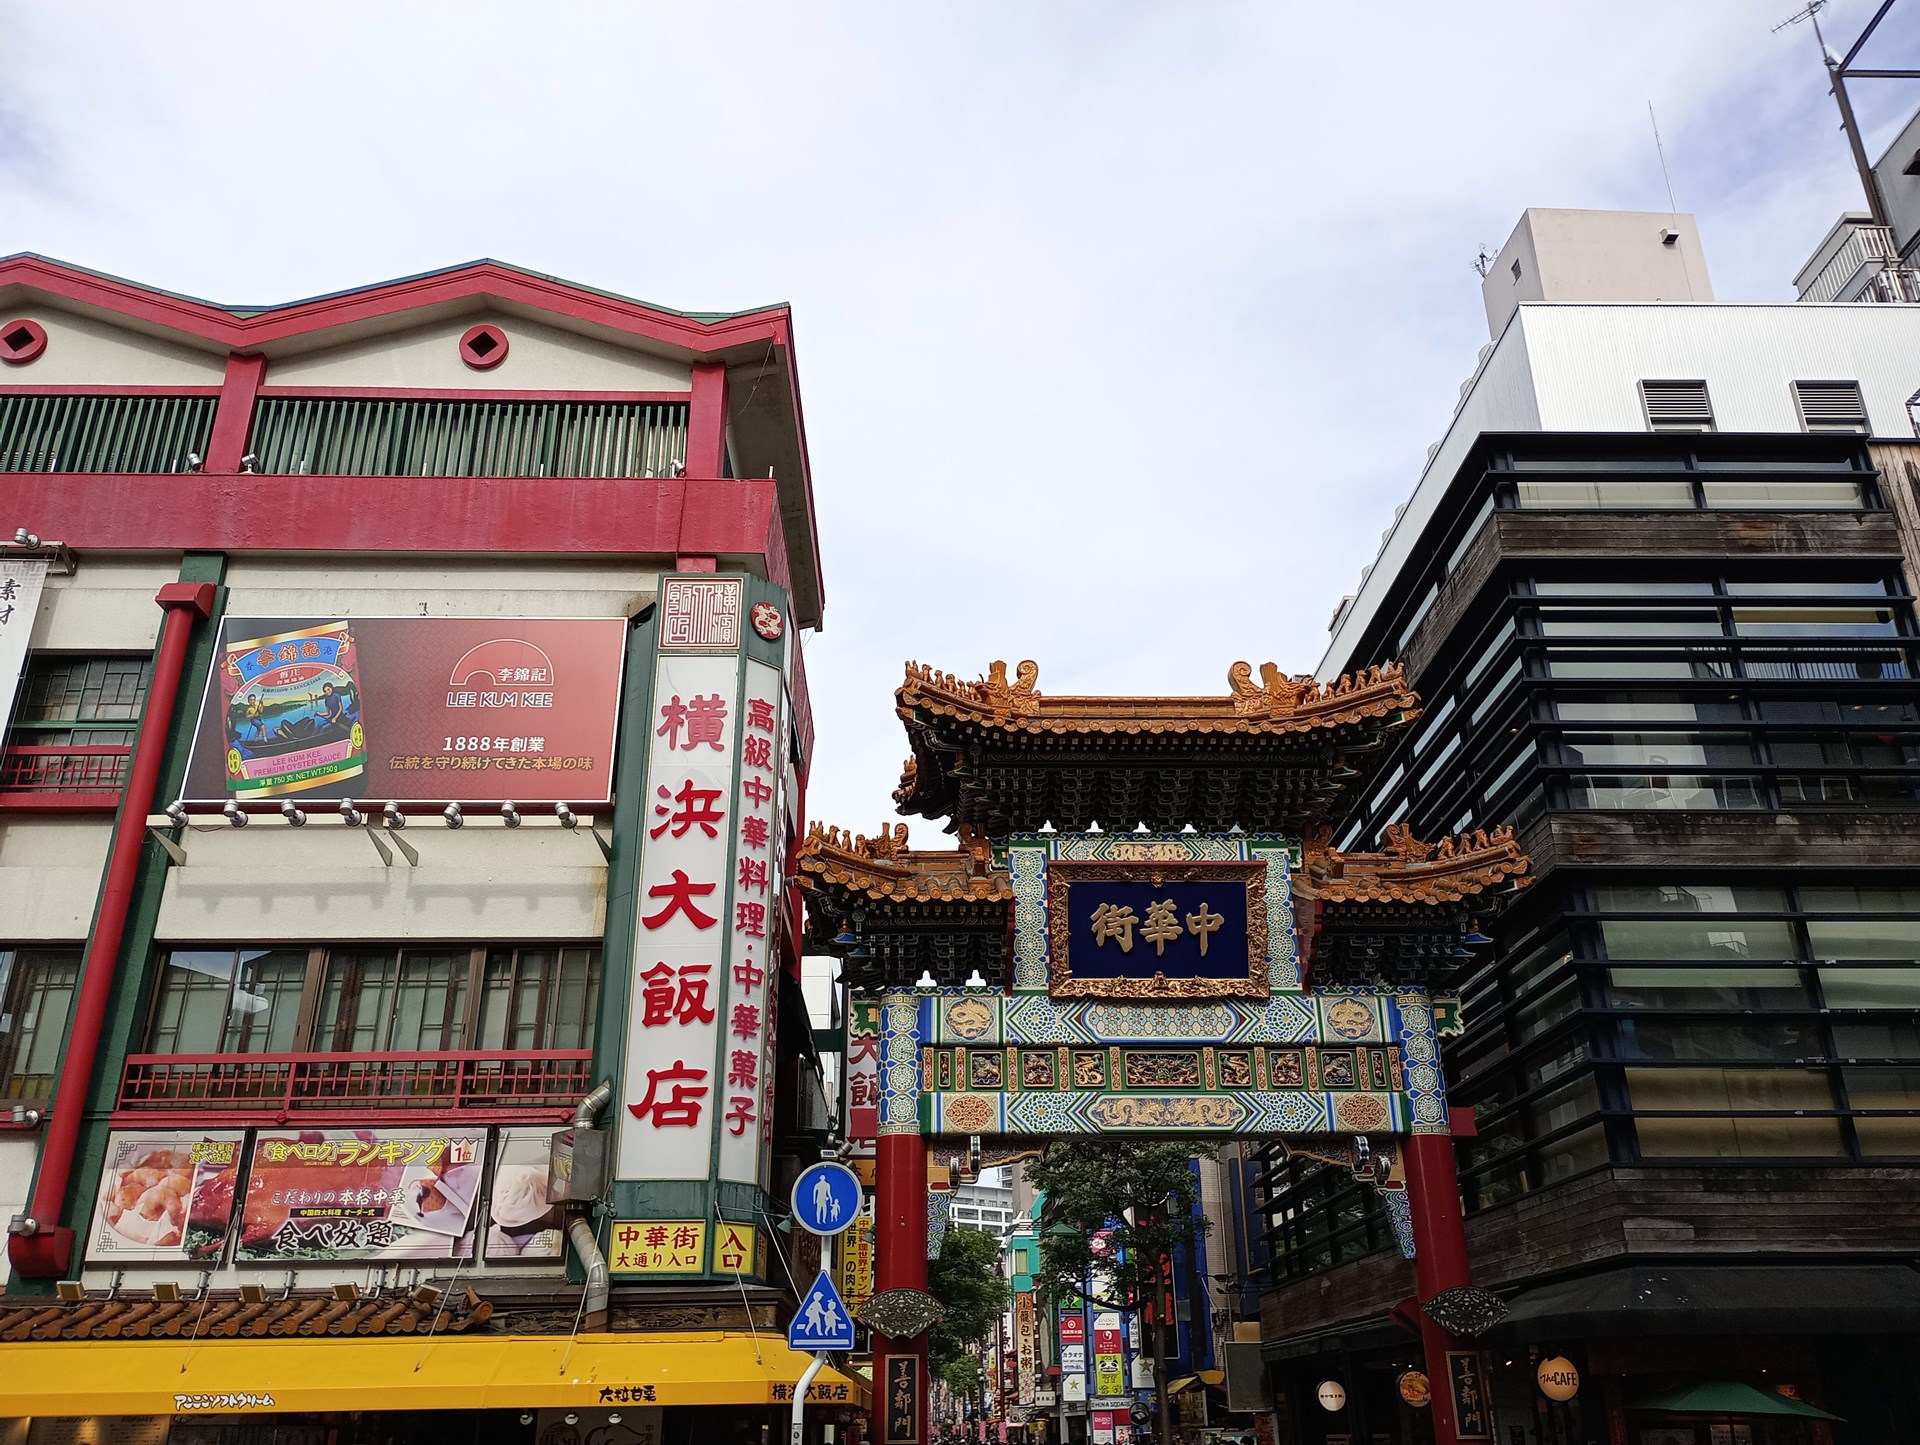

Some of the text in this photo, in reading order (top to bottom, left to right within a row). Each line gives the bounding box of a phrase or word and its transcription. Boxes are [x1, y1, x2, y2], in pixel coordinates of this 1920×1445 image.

[257, 641, 321, 668] 李錦記
[497, 667, 547, 682] 李錦記
[446, 692, 553, 707] LEE KUM KEE
[442, 736, 545, 752] 1888年創業
[253, 752, 341, 777] PREMIUM OYSTER SAUCE
[272, 750, 321, 766] LEE KUM KEE
[389, 756, 593, 770] 伝統を守り続けてきた本場の味
[627, 693, 728, 1129] 横浜大飯店
[454, 1147, 472, 1162] 1位
[275, 1219, 393, 1252] 食べ放題
[618, 1225, 700, 1251] 中華街
[720, 1227, 747, 1269] 入口
[616, 1252, 698, 1268] 大通り入口
[1540, 1371, 1577, 1387] The CAFE
[599, 1385, 657, 1403] 大粒甘栗
